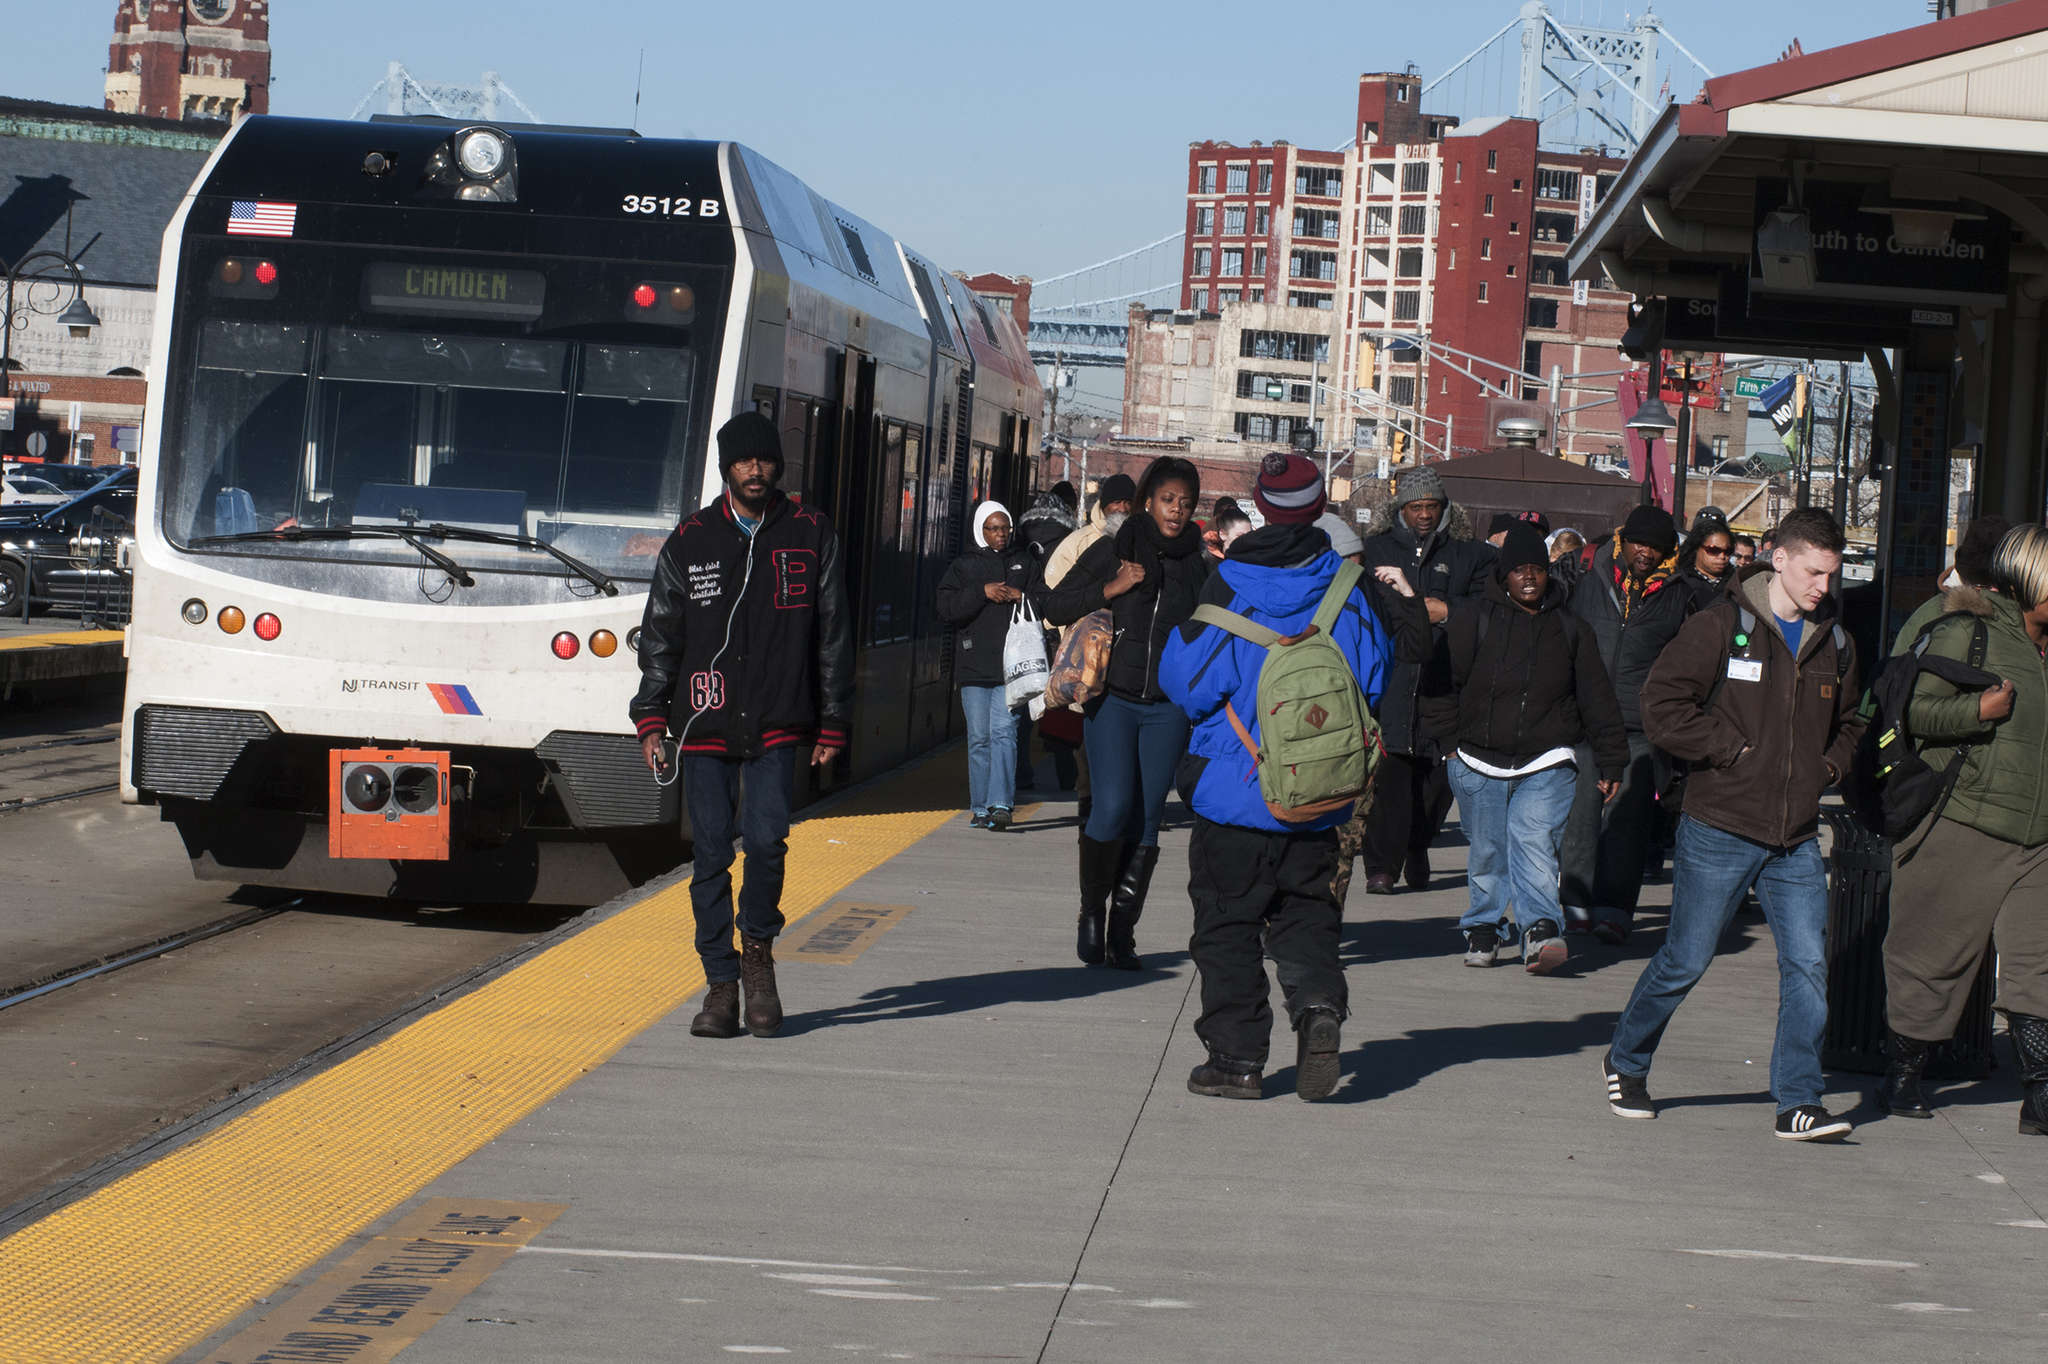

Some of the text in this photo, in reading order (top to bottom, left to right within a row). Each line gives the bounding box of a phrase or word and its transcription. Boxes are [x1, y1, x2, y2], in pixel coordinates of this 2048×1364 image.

[622, 194, 719, 217] 3512 B
[1856, 231, 1878, 252] to
[405, 268, 507, 300] CAMDEN
[342, 679, 421, 693] NJ TRANSIT
[690, 671, 725, 711] 68
[308, 1283, 433, 1326] BEHIND
